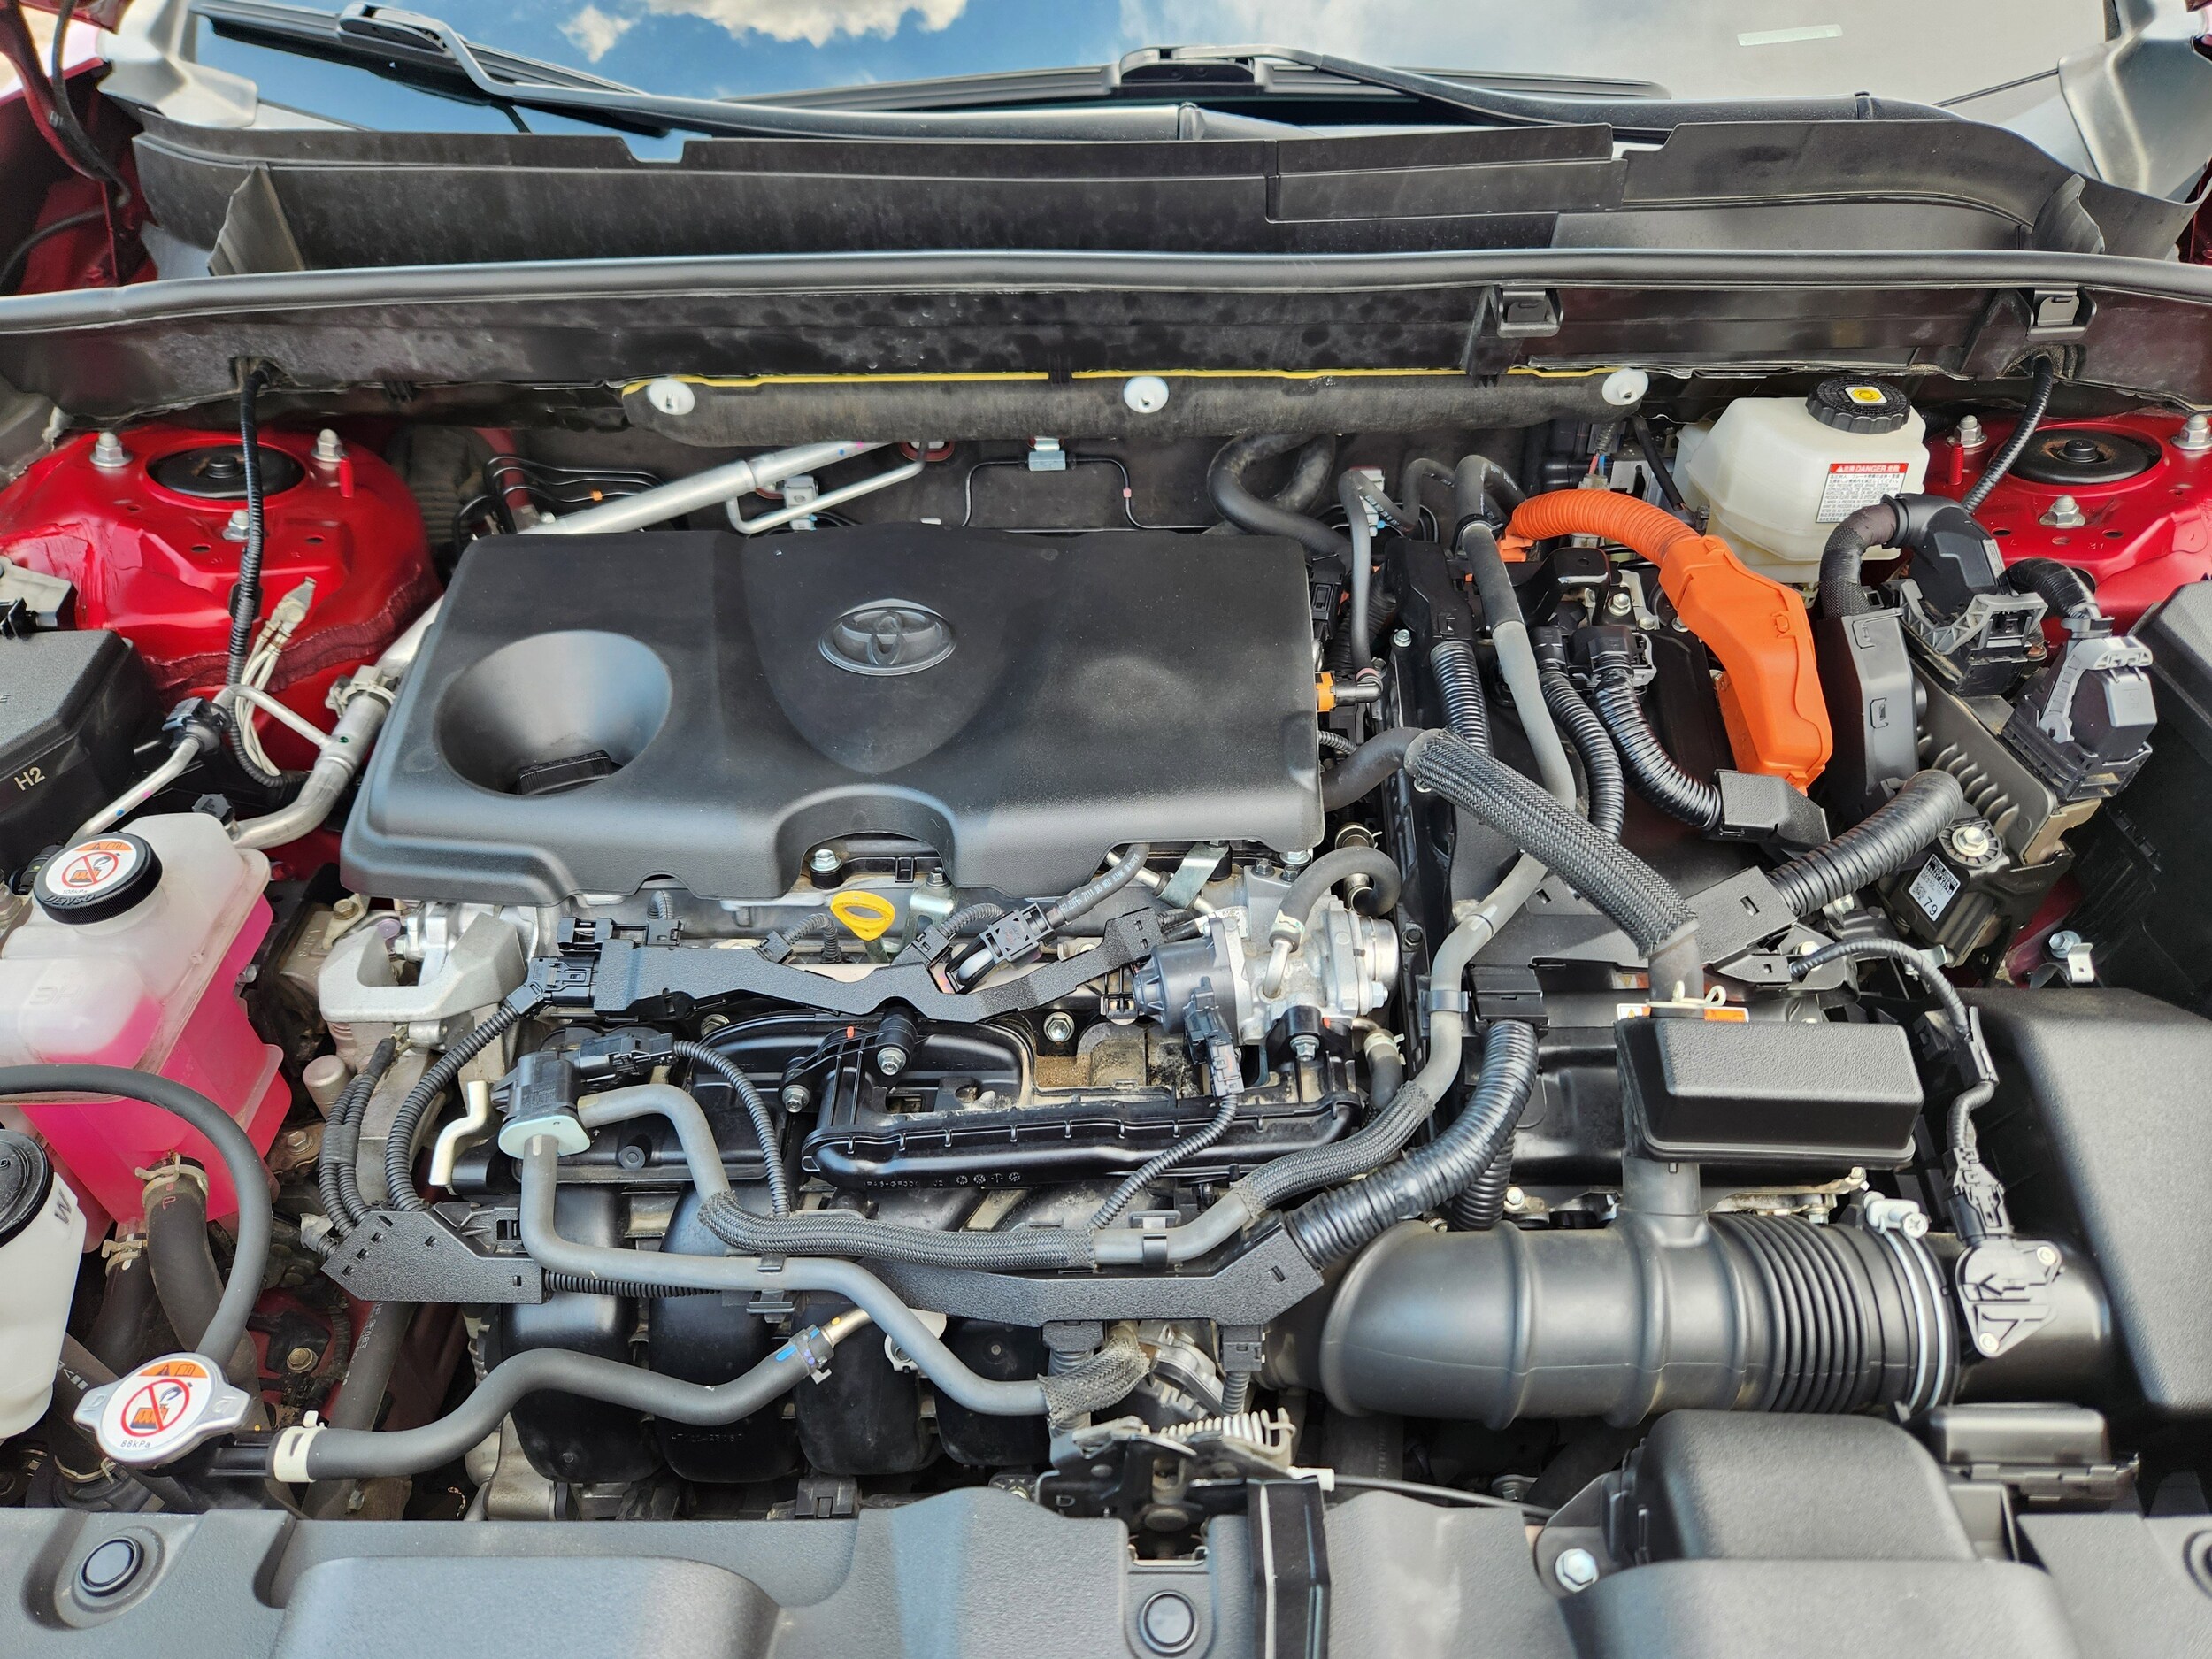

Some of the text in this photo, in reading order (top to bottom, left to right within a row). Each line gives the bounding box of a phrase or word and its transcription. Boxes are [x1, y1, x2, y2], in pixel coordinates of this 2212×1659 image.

[13, 766, 46, 792] H2
[1102, 878, 1112, 889] NOT
[1932, 866, 1952, 887] TOYOTA
[43, 894, 96, 906] DENSO
[1924, 896, 1938, 916] 79
[54, 1187, 73, 1225] W
[120, 1440, 151, 1448] 88kPa
